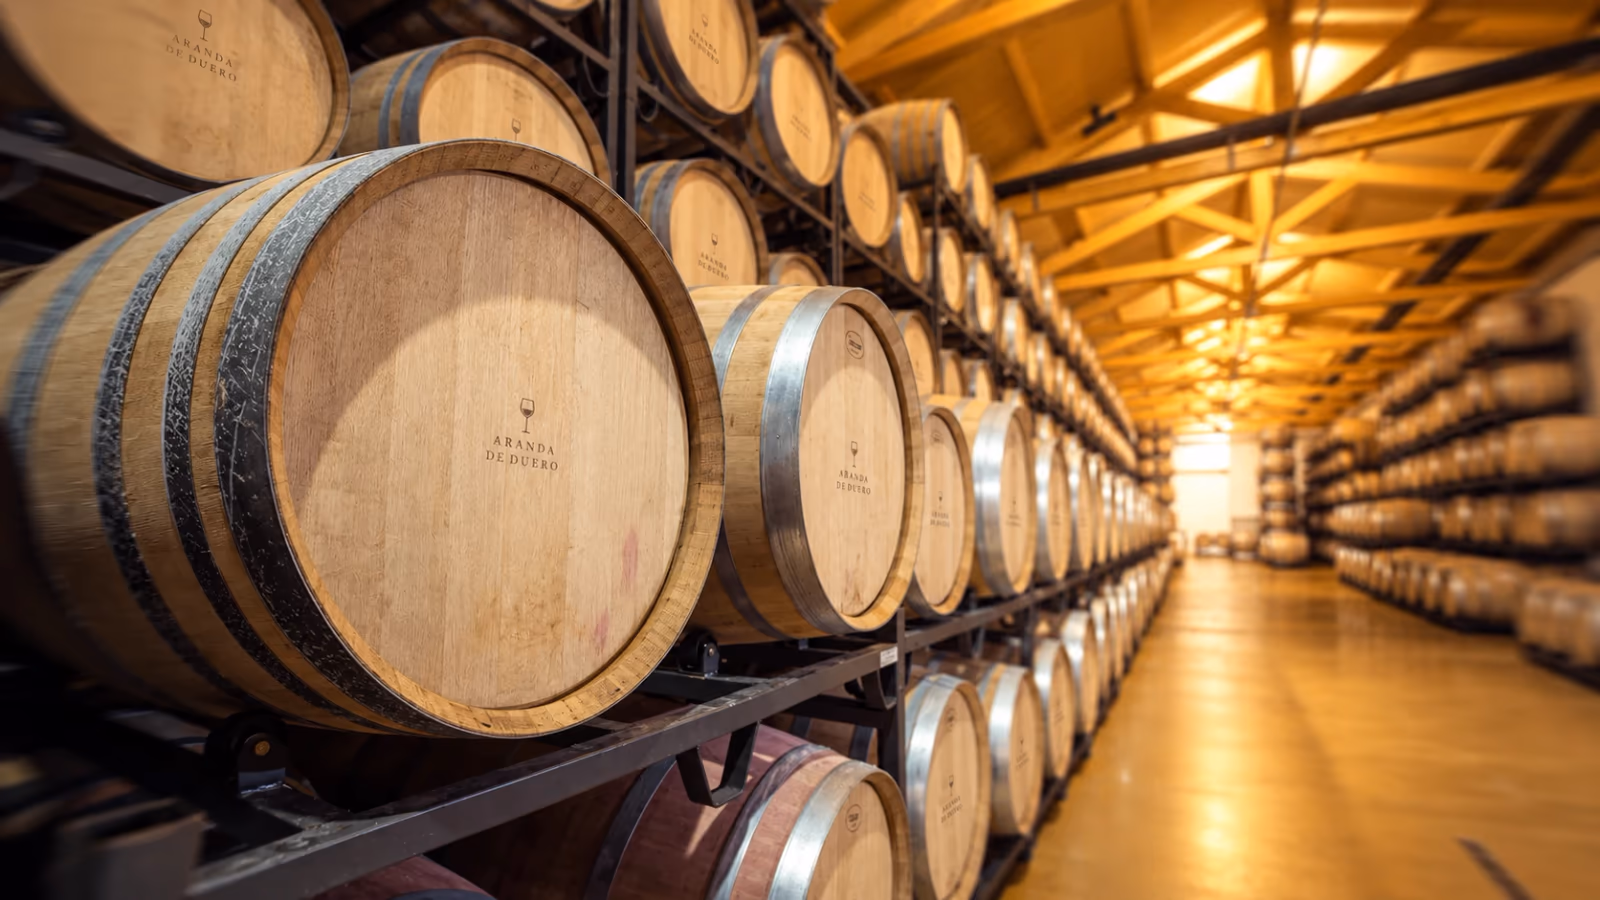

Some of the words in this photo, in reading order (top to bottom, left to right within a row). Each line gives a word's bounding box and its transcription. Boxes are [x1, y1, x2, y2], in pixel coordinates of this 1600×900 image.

[172, 34, 233, 68] ARANDA
[165, 44, 184, 59] DE
[188, 54, 237, 82] DUERO
[493, 435, 554, 456] ARANDA
[486, 449, 504, 463] DE
[510, 453, 558, 471] DUERO
[836, 480, 846, 490] DE
